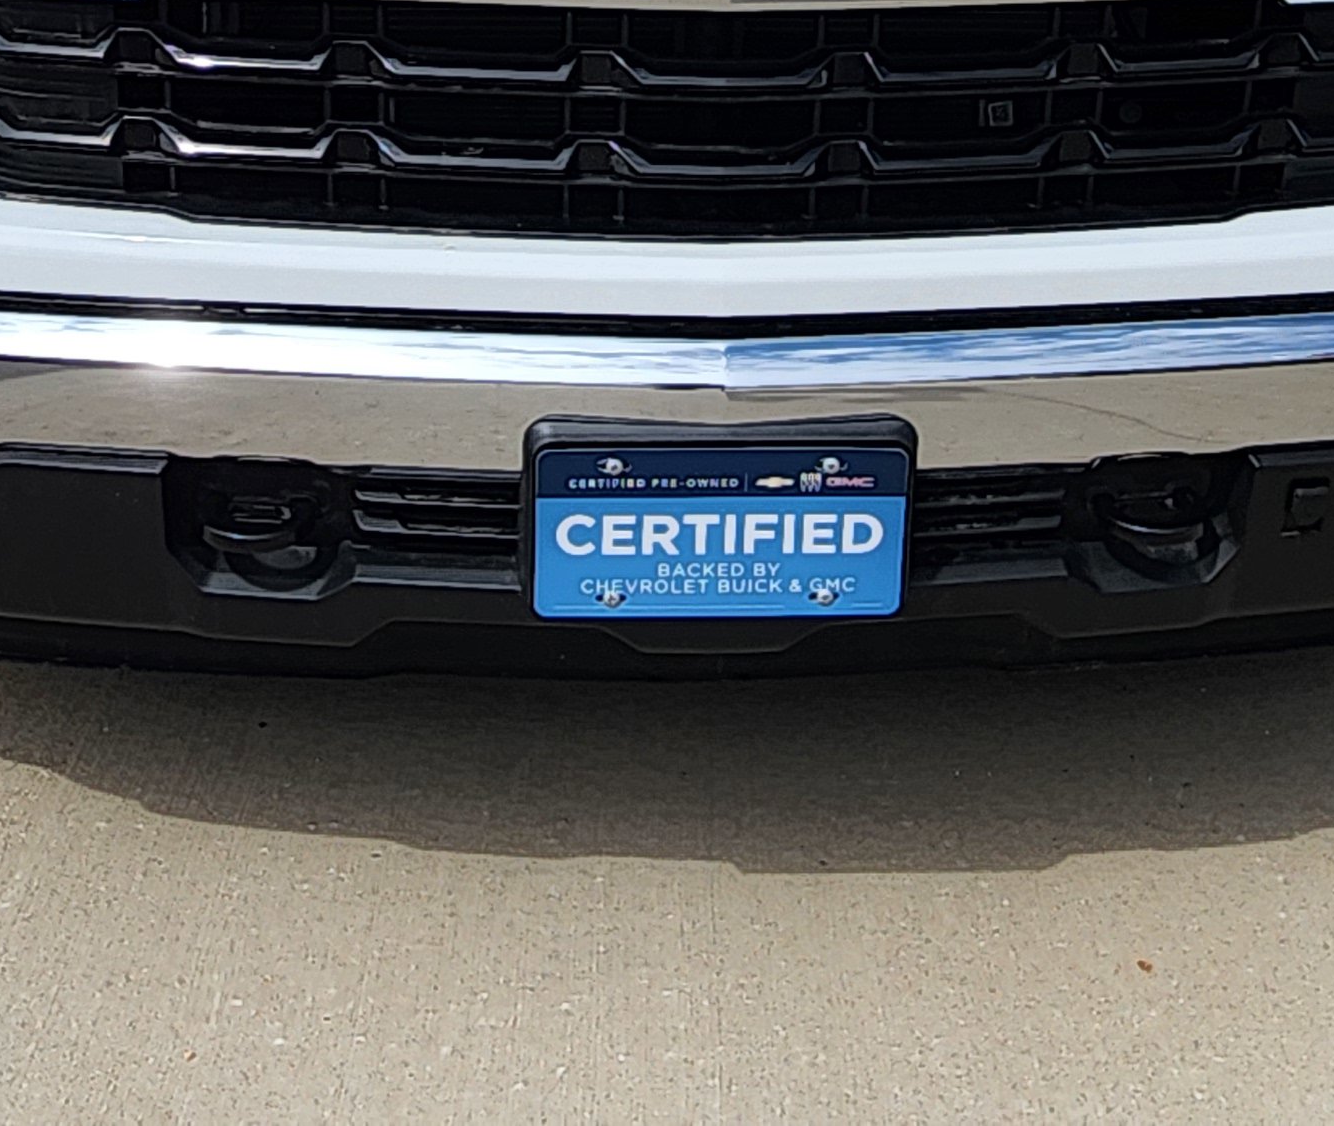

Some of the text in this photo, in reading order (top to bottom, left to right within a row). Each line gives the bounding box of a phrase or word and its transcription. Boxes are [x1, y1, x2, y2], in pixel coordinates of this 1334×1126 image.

[568, 478, 740, 489] CERTIFIED PRE-OWNED
[825, 476, 875, 487] GMC
[555, 514, 884, 556] CERTIFIED
[657, 562, 781, 577] BACKED BY
[580, 578, 856, 594] CHEVROLET BUICK & GMC
